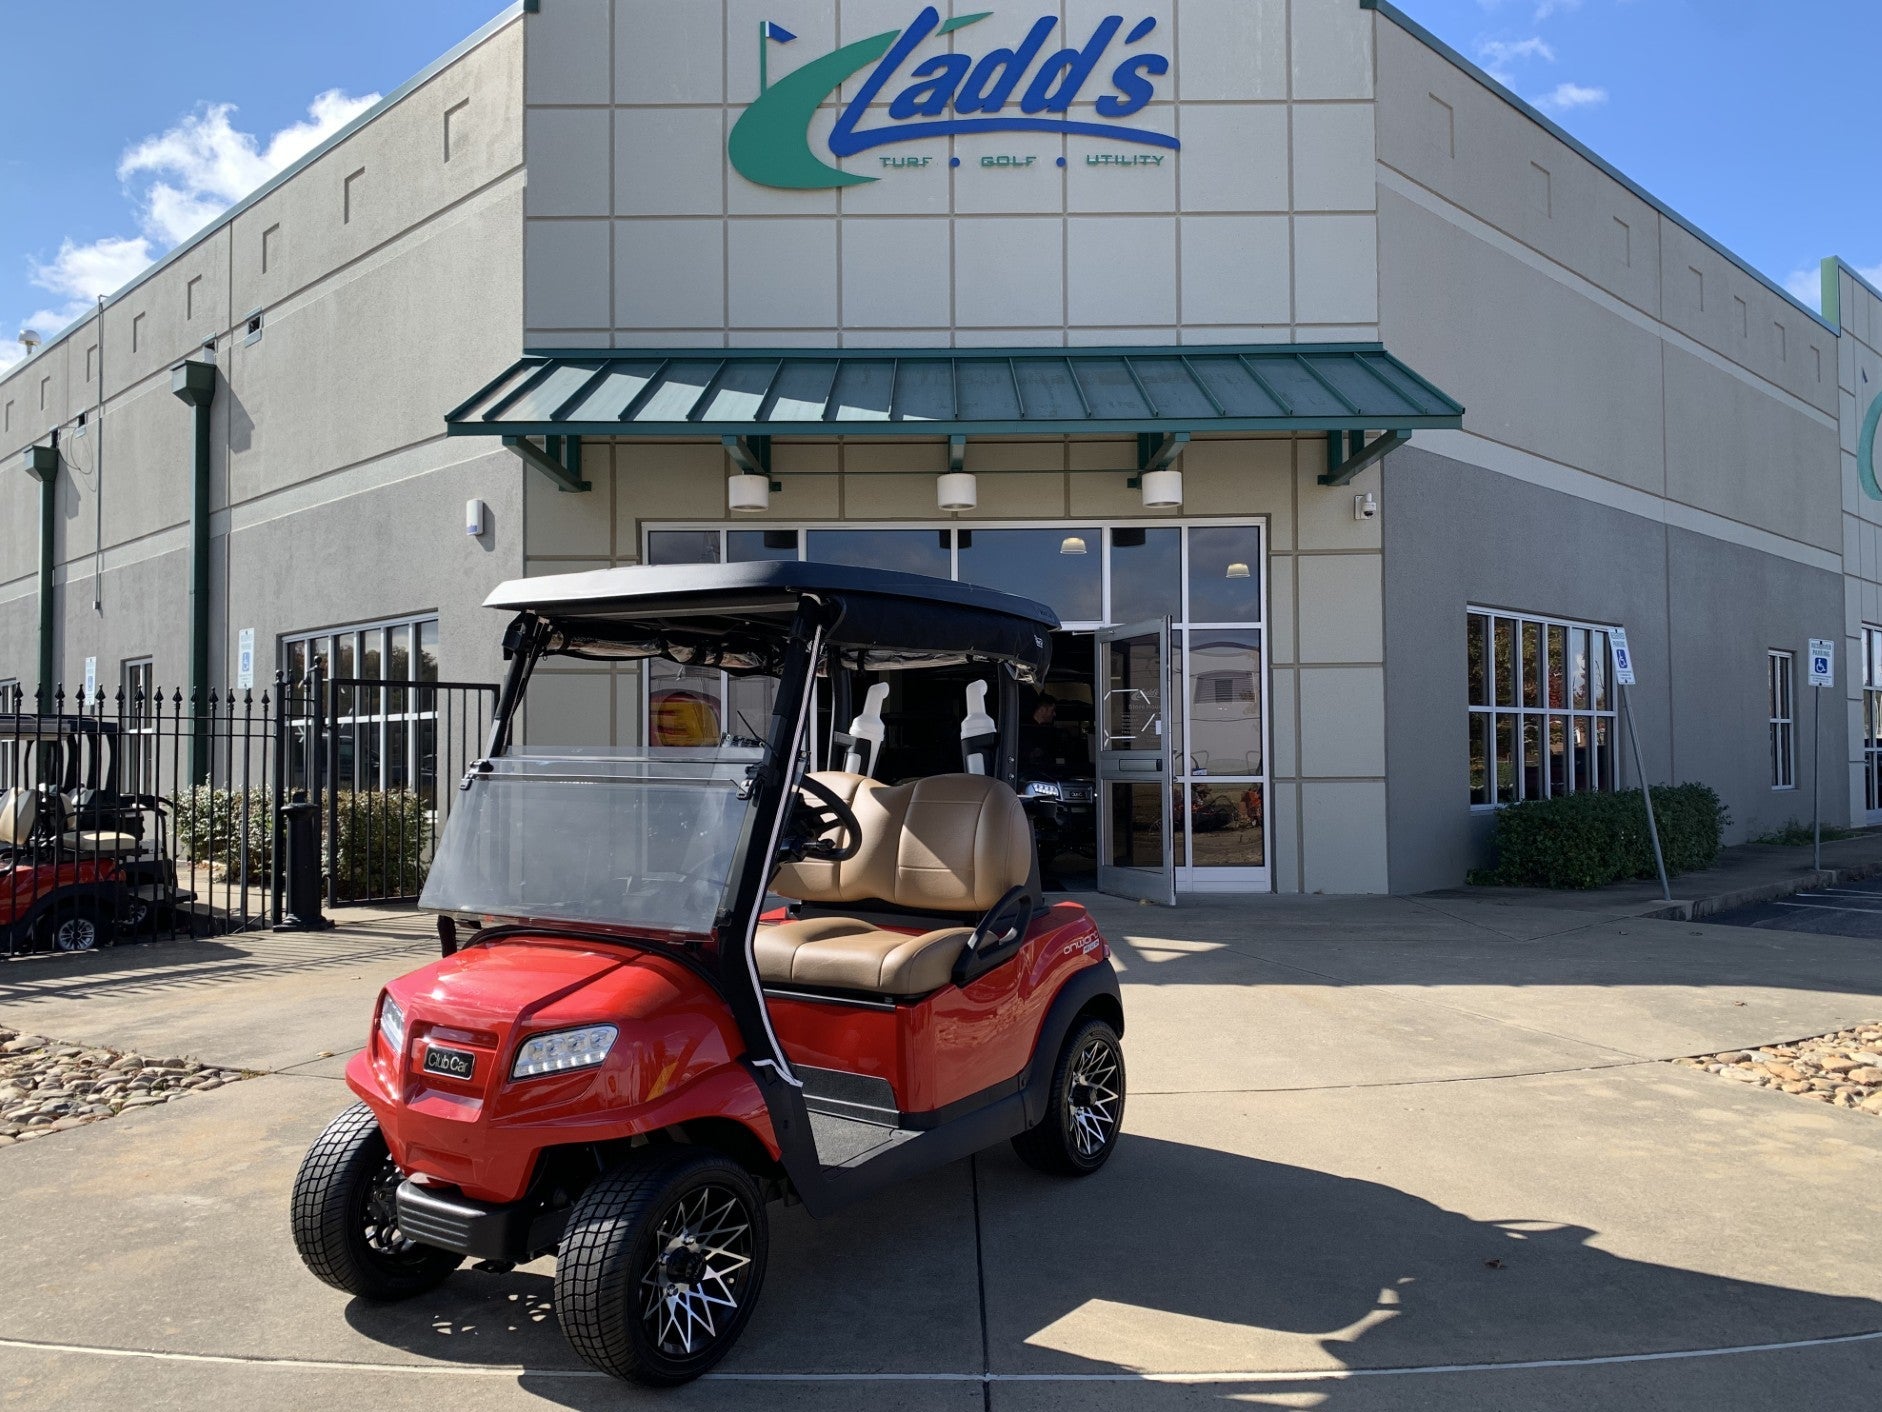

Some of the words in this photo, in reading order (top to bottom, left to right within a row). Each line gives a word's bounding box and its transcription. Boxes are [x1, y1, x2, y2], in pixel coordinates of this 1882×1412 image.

[828, 6, 1181, 157] Ladd's
[879, 156, 933, 168] TURF
[980, 155, 1037, 168] GOLF
[1086, 154, 1165, 167] UTILITY
[428, 1052, 450, 1069] Club
[450, 1056, 468, 1072] Car
